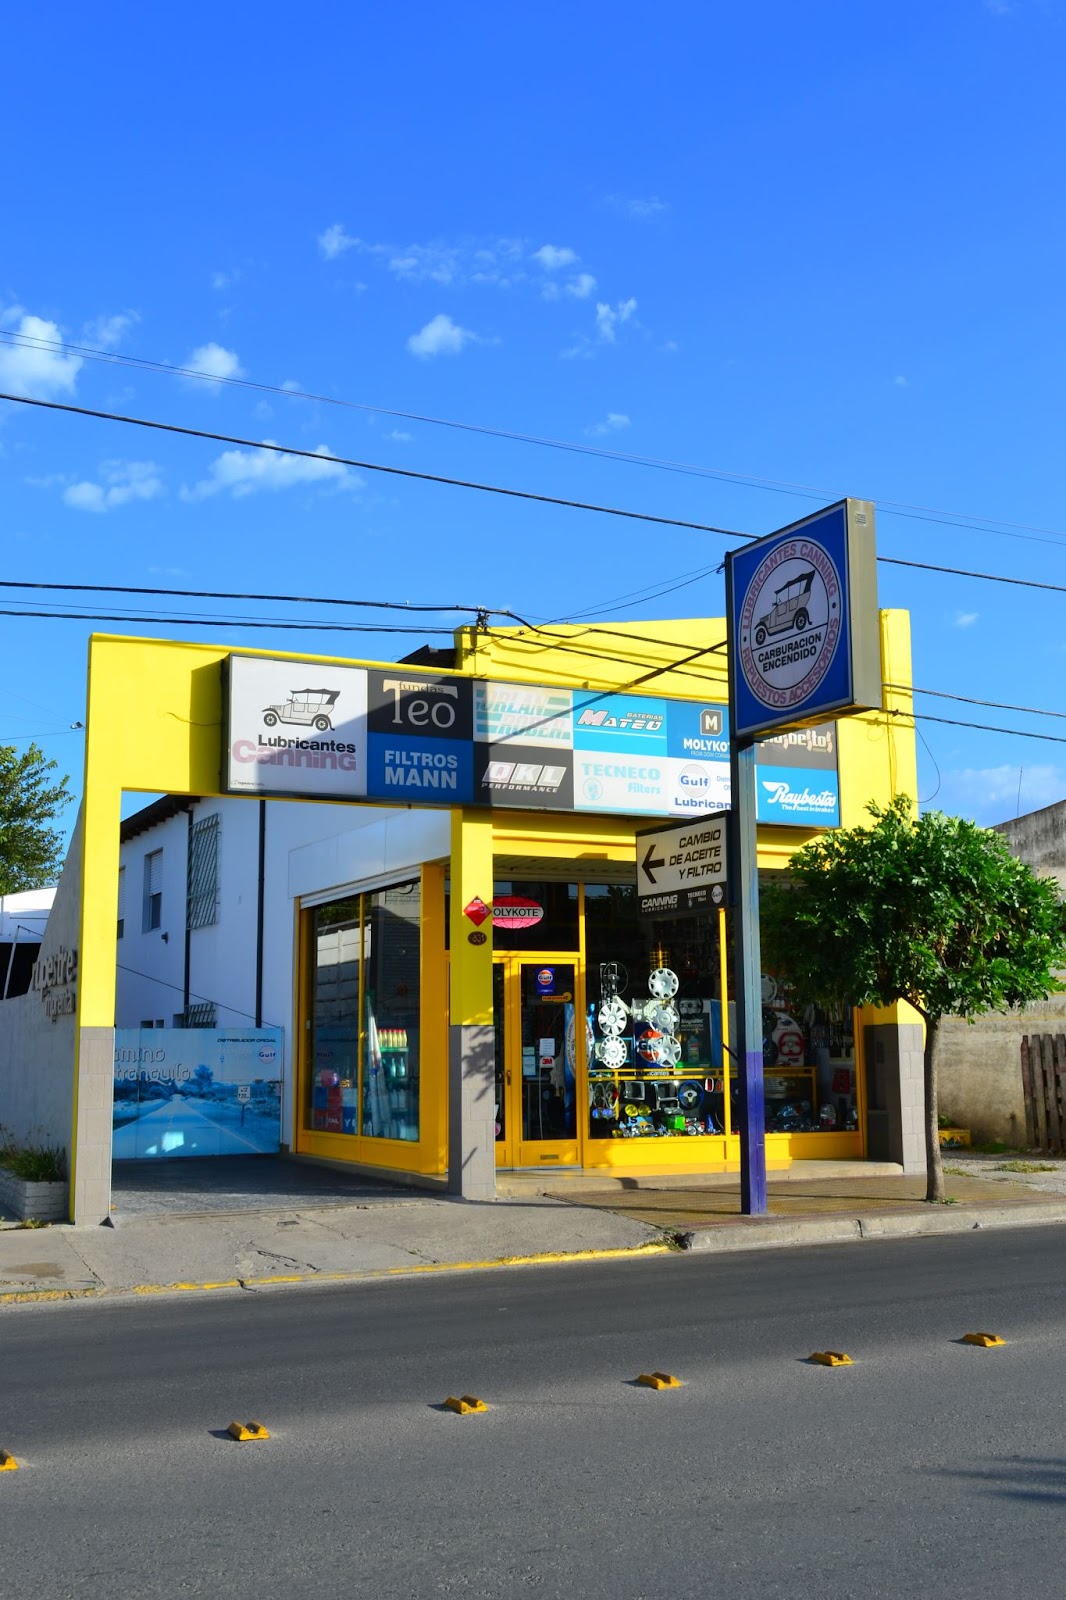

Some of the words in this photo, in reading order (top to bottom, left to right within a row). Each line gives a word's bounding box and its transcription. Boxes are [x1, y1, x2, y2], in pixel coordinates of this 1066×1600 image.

[743, 543, 796, 629] LUBRICANTES
[800, 543, 837, 597] CANNING
[758, 632, 822, 663] CARBURACION
[743, 646, 787, 705] REPUESTOS
[787, 617, 838, 704] ACCESORIOS
[762, 645, 817, 673] ENCENDIDO
[257, 734, 357, 754] Lubricantes
[384, 749, 458, 769] FILTROS
[384, 766, 457, 789] MANN
[581, 762, 661, 780] TECNECO
[680, 775, 708, 787] Gulf
[481, 782, 559, 793] PERFORMANCE
[627, 782, 661, 795] Filters
[679, 829, 721, 849] CAMBIO
[669, 854, 683, 866] DE
[683, 846, 721, 863] ACEITE
[679, 868, 686, 879] Y
[686, 862, 722, 878] FILTRO
[641, 894, 678, 908] CANNING
